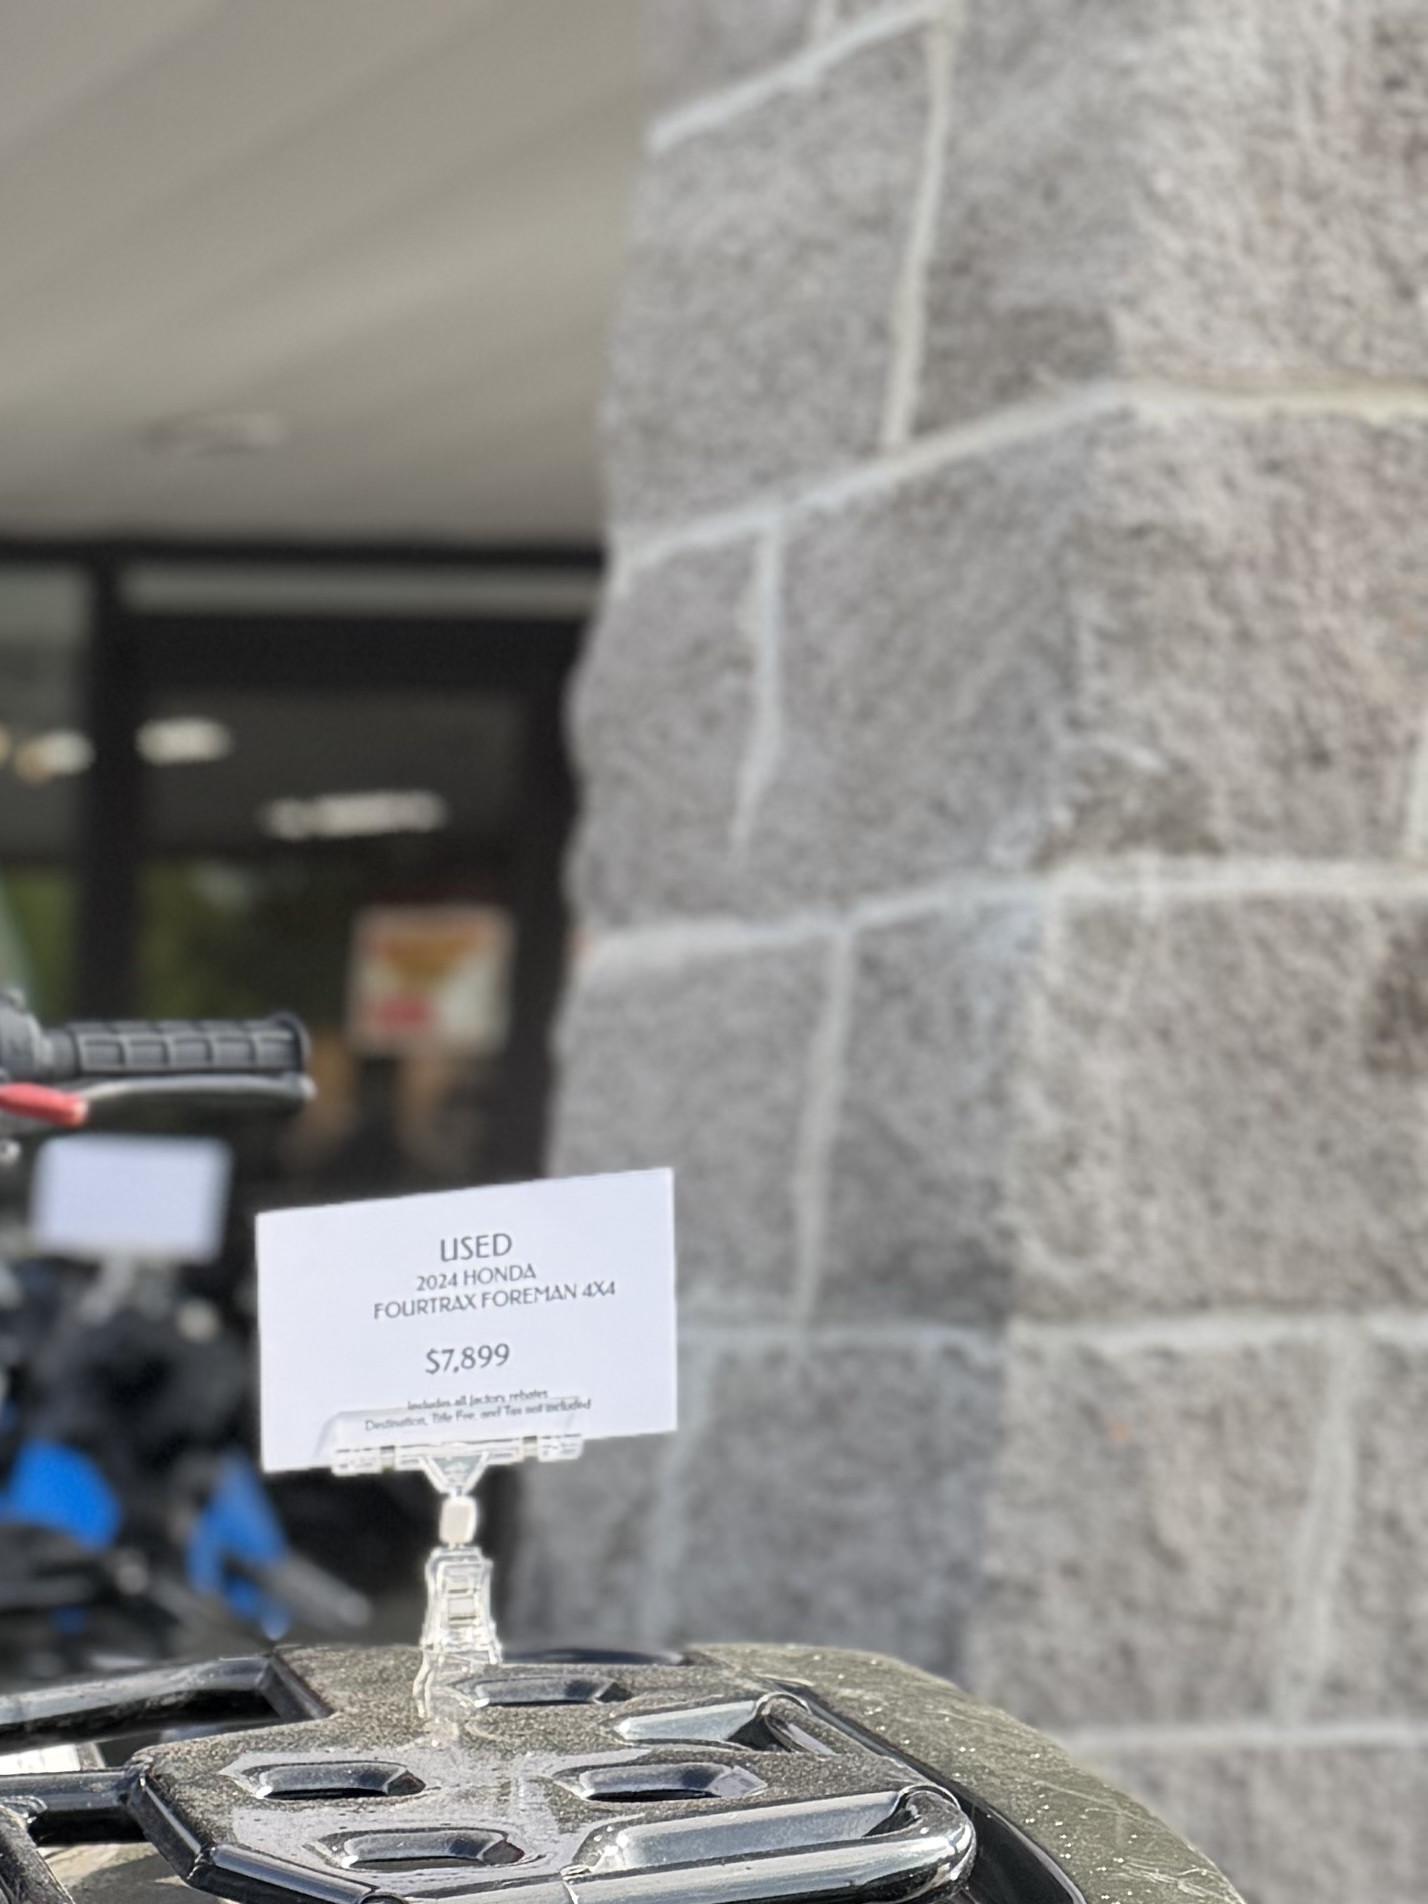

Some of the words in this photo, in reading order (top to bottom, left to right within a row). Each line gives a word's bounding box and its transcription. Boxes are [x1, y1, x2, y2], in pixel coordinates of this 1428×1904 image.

[440, 1233, 512, 1262] USED
[416, 1272, 458, 1291] 2024
[464, 1263, 537, 1286] HONDA
[374, 1294, 477, 1320] FOURTRAX
[481, 1283, 577, 1309] FOREMAN
[582, 1281, 616, 1298] 4X4
[425, 1343, 510, 1375] $7,899
